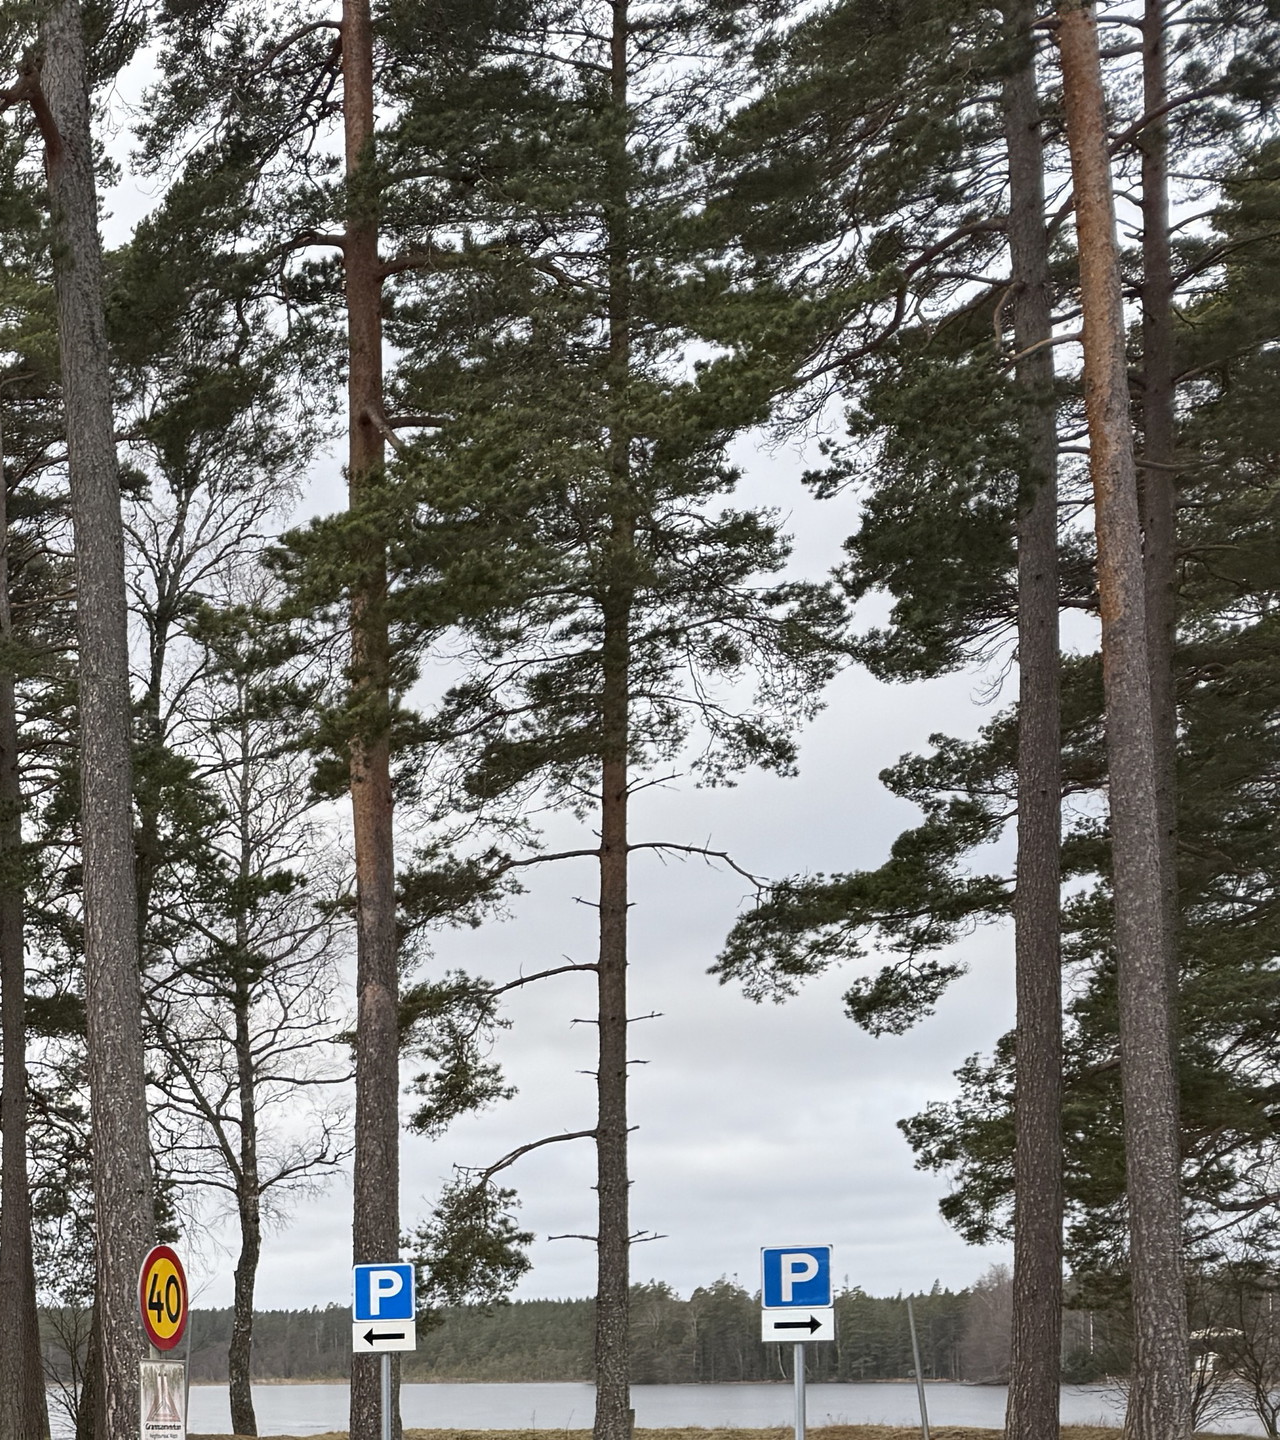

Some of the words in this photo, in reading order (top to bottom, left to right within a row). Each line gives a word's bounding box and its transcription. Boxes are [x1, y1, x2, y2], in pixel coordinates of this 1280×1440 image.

[148, 1273, 182, 1323] 40
[370, 1270, 403, 1316] P
[781, 1253, 819, 1302] P
